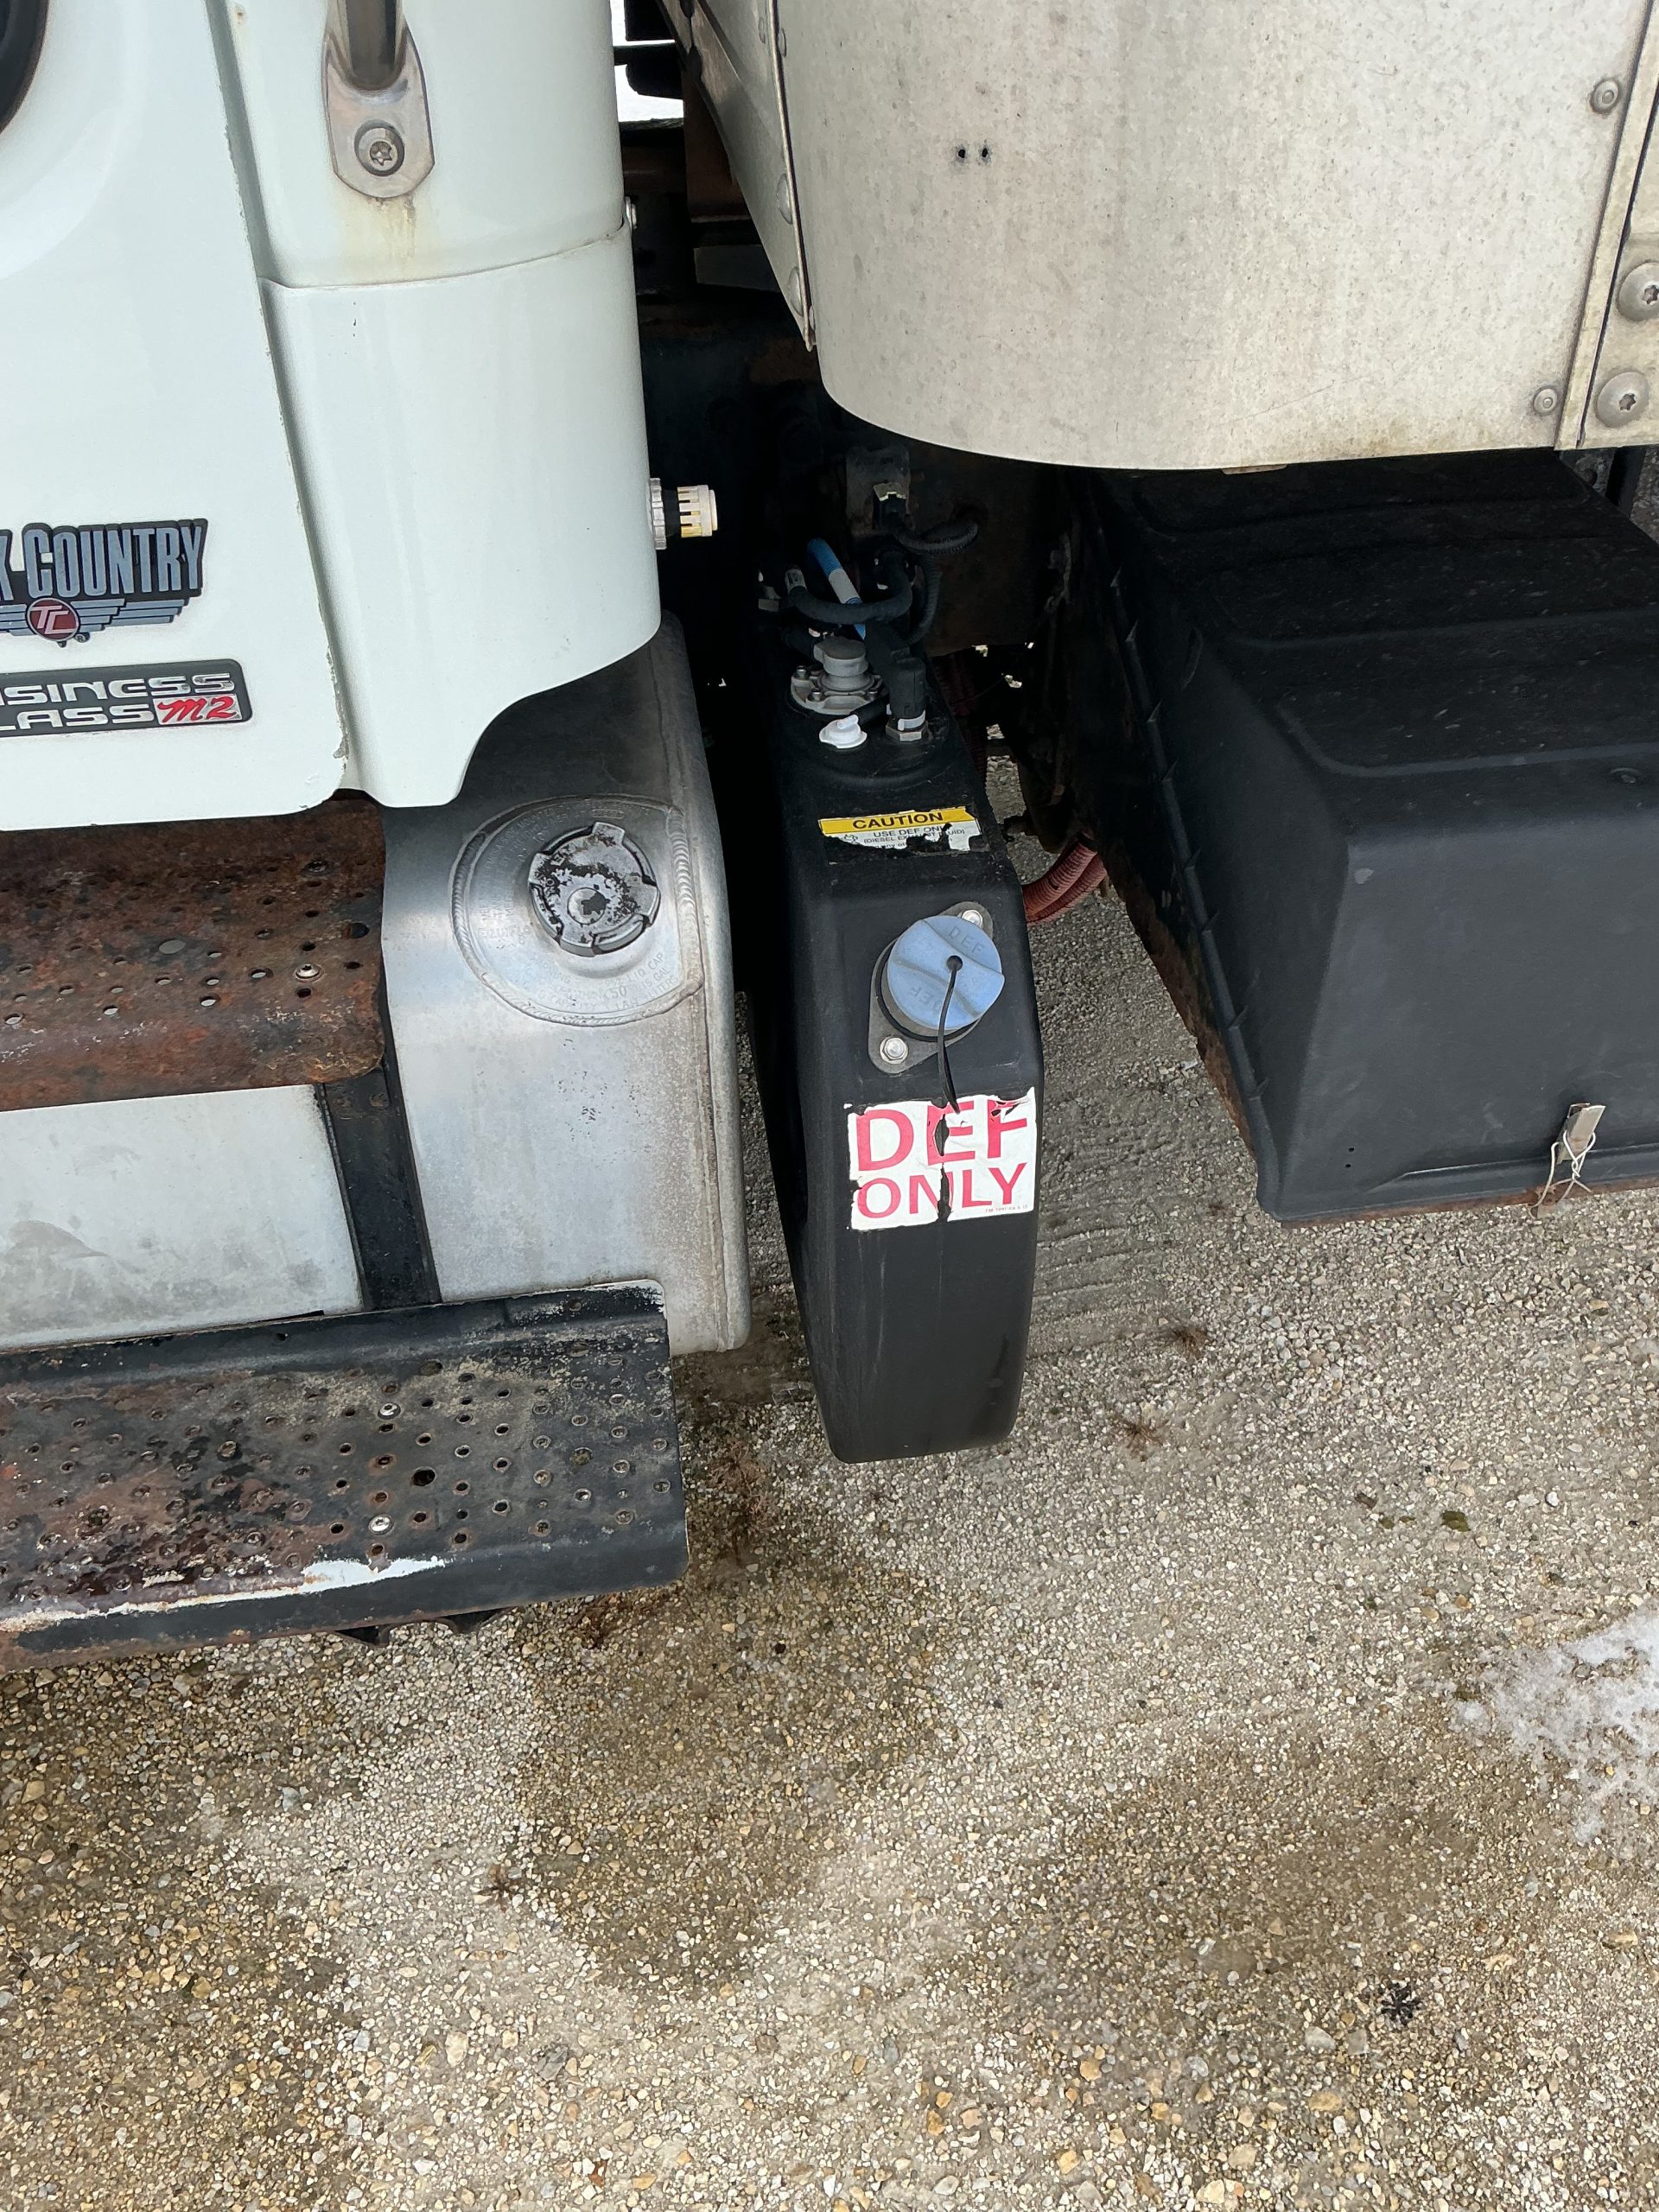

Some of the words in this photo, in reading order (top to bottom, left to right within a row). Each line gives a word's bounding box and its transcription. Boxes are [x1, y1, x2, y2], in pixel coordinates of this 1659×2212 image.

[22, 525, 204, 599] COUNTRY
[0, 672, 235, 707] SINESS
[852, 811, 944, 830] CAUTION
[873, 830, 897, 838] USE
[899, 827, 921, 836] DEF
[923, 824, 944, 833] ON
[948, 925, 985, 954] DEF
[856, 1098, 1027, 1172] DEF
[857, 1162, 1027, 1219] ONLY
